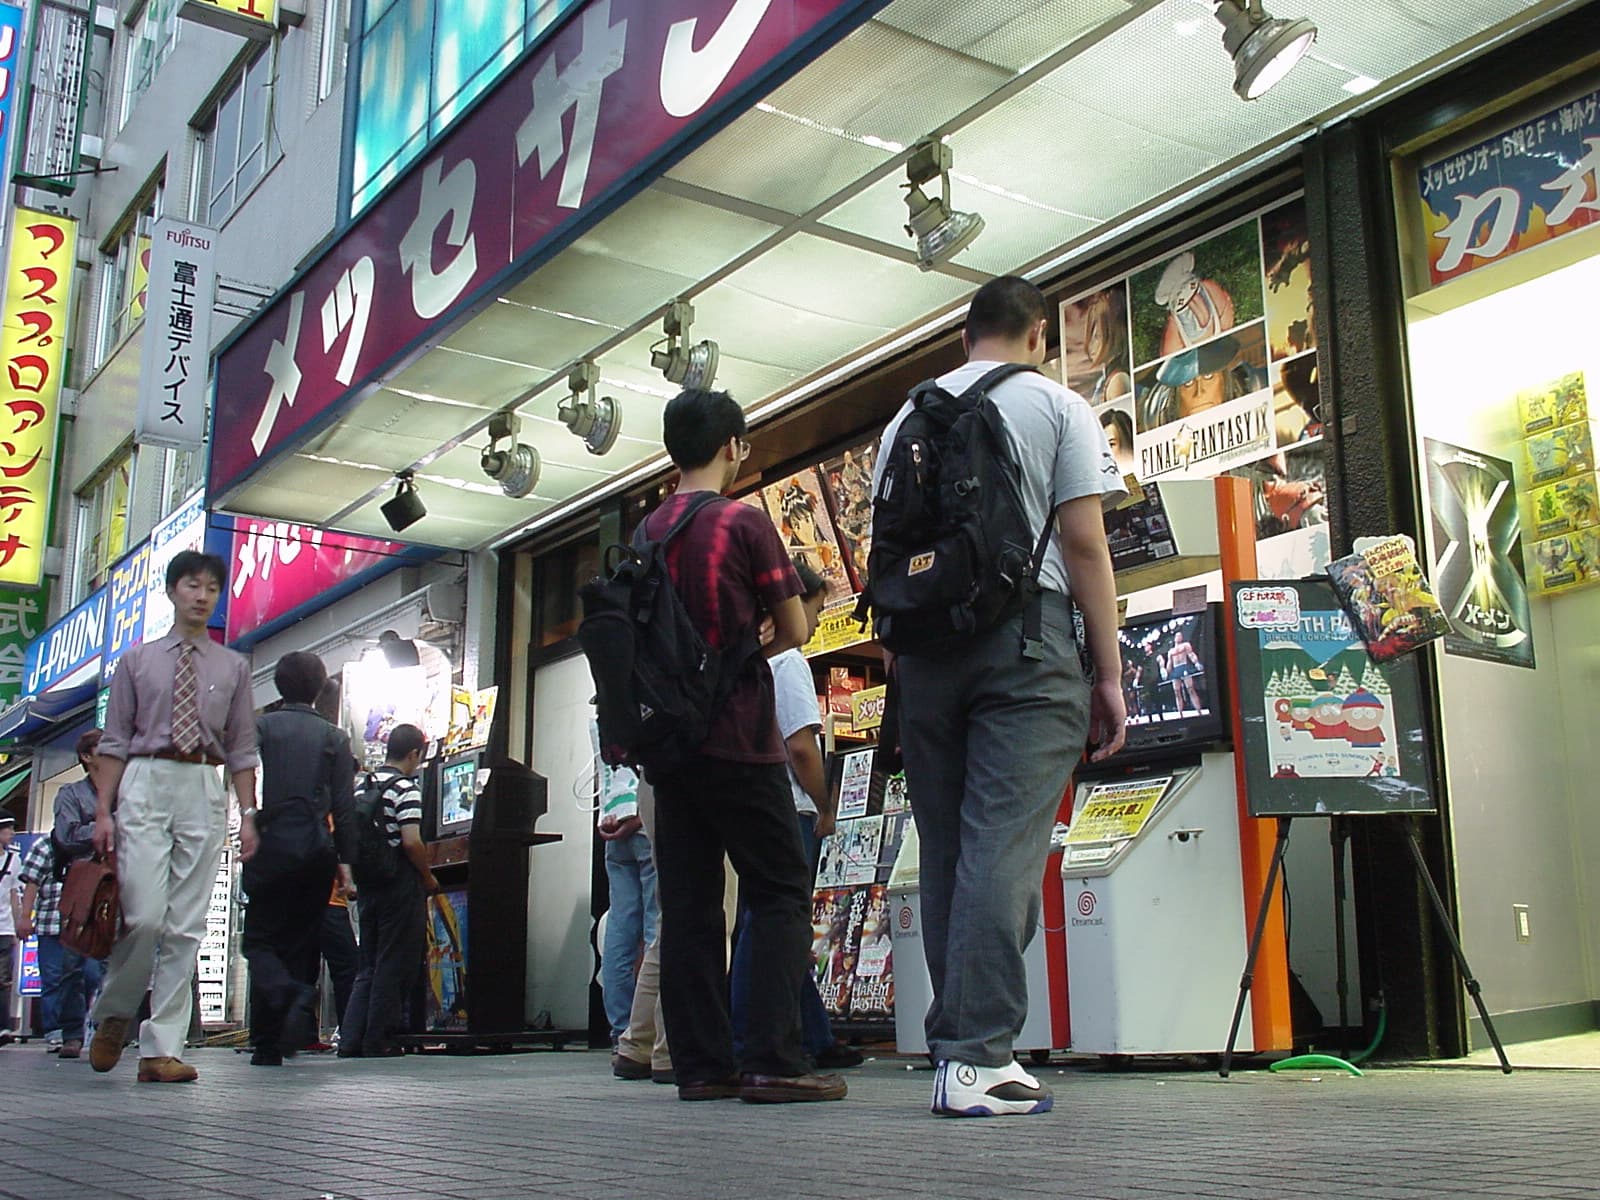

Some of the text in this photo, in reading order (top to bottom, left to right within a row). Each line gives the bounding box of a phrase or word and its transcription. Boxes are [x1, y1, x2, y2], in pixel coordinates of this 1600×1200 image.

[166, 229, 210, 250] FUJITSU
[160, 260, 198, 425] 富士通デバイス
[1141, 438, 1180, 477] FINAL
[1192, 411, 1251, 460] FANTASY
[233, 523, 322, 598] メッセ
[852, 982, 890, 998] HAREM
